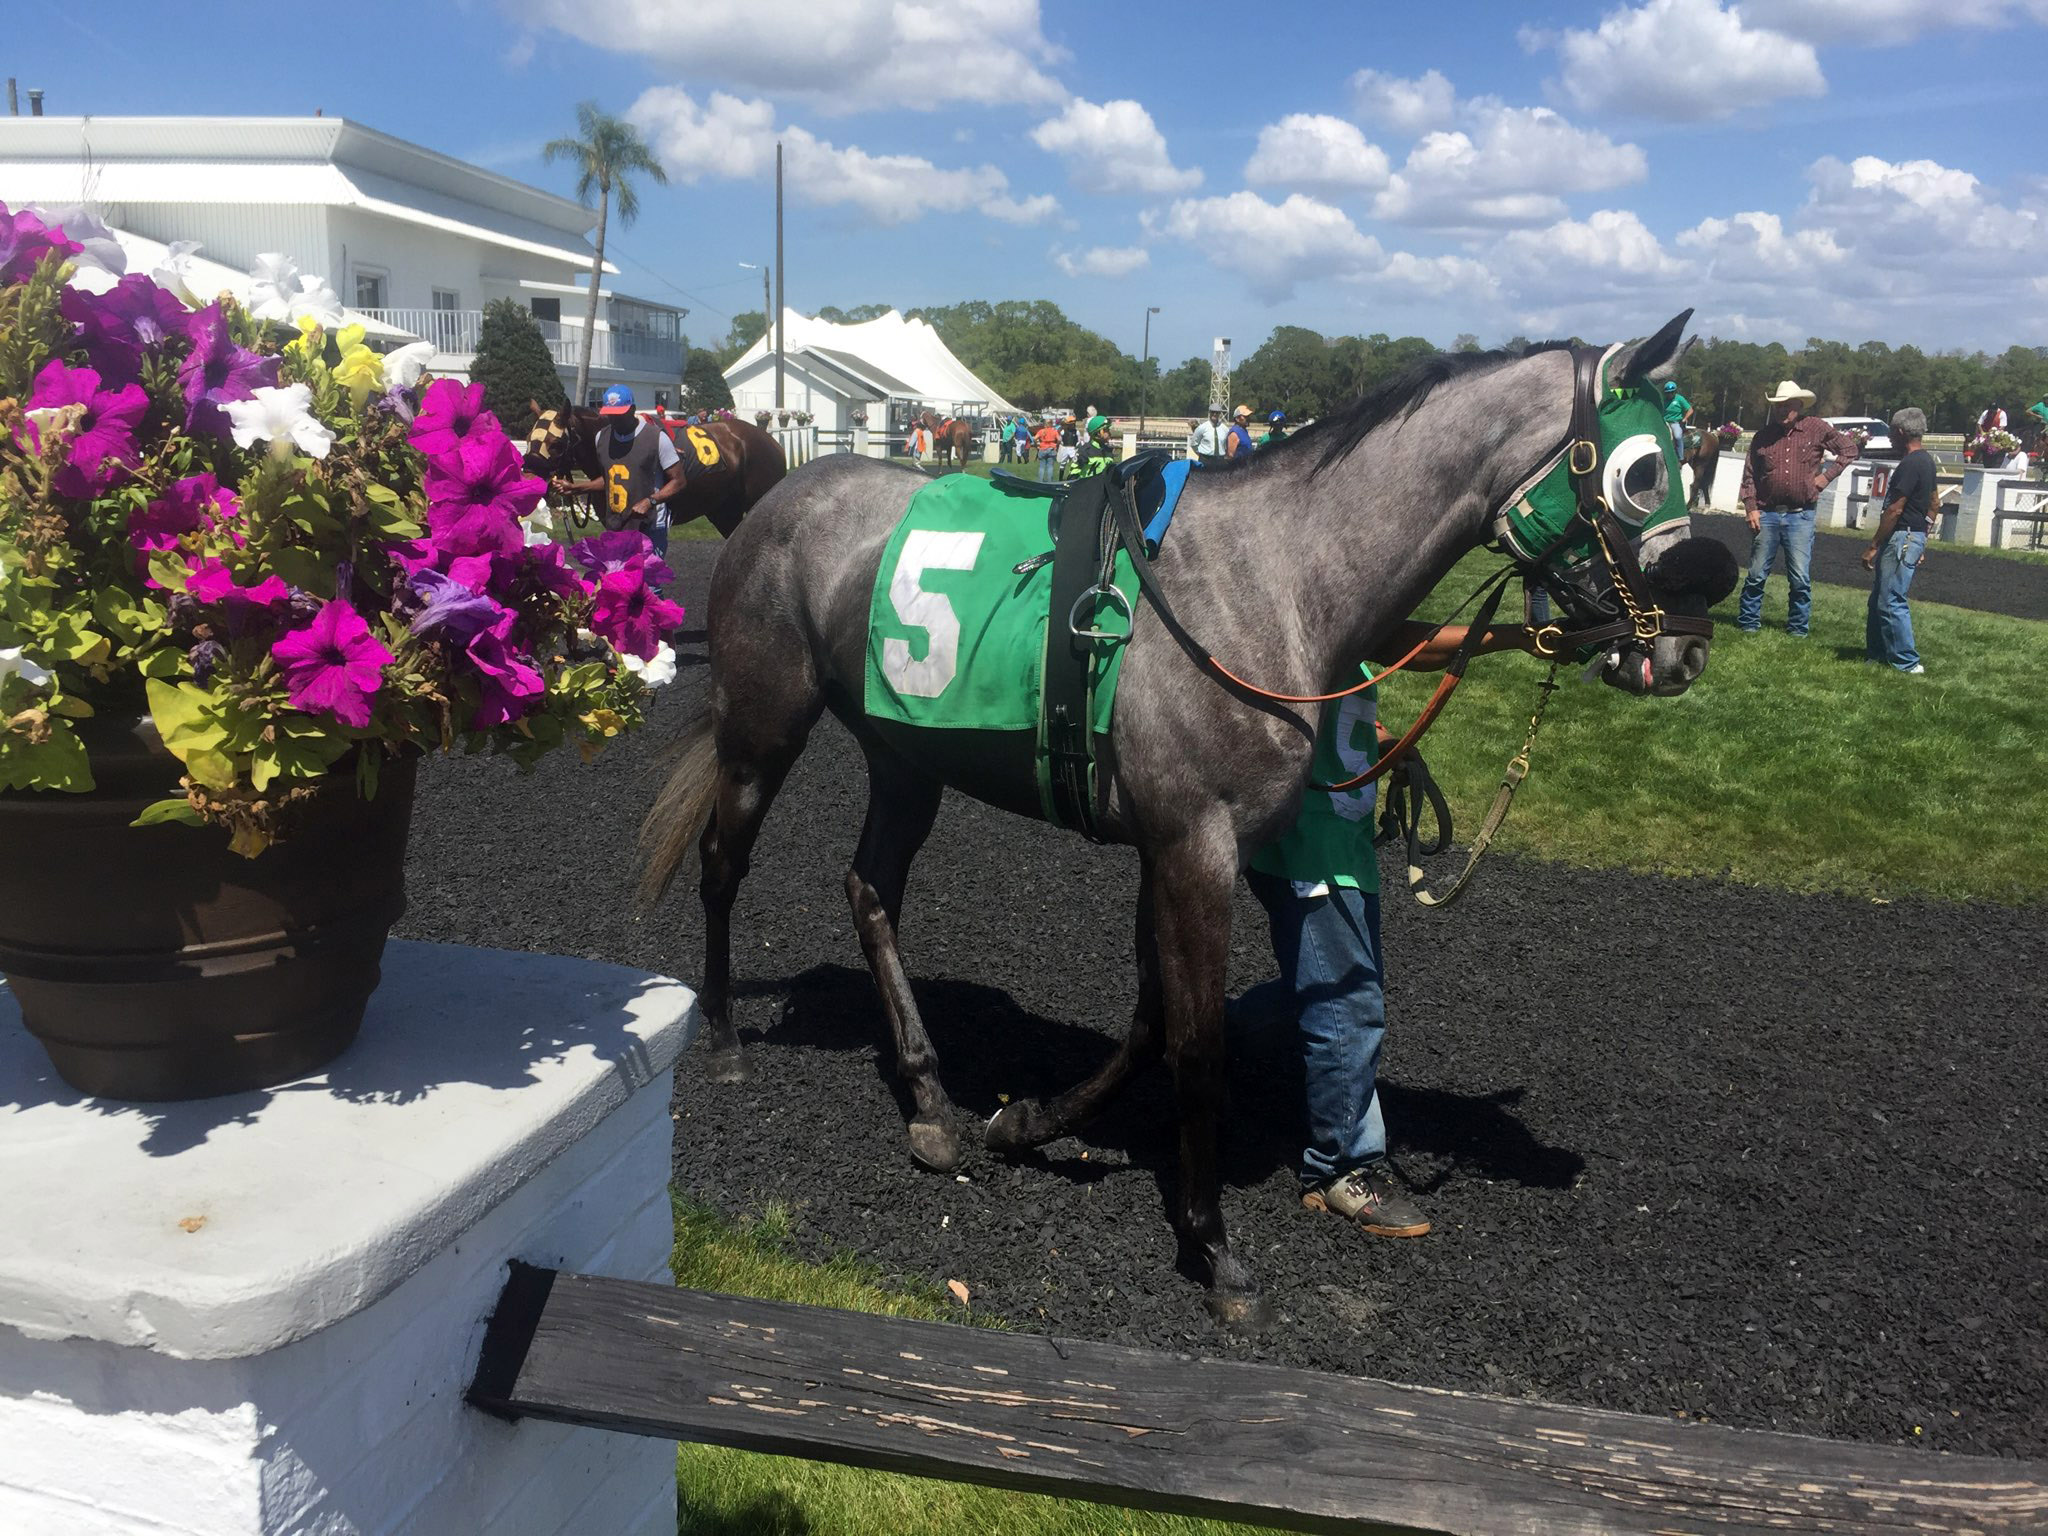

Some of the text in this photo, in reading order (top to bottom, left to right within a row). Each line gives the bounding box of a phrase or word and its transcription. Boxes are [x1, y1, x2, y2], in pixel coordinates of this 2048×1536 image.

[687, 425, 720, 466] 6
[990, 431, 998, 442] 10
[608, 464, 630, 513] 6
[883, 530, 985, 698] 5
[1325, 694, 1377, 822] 5
